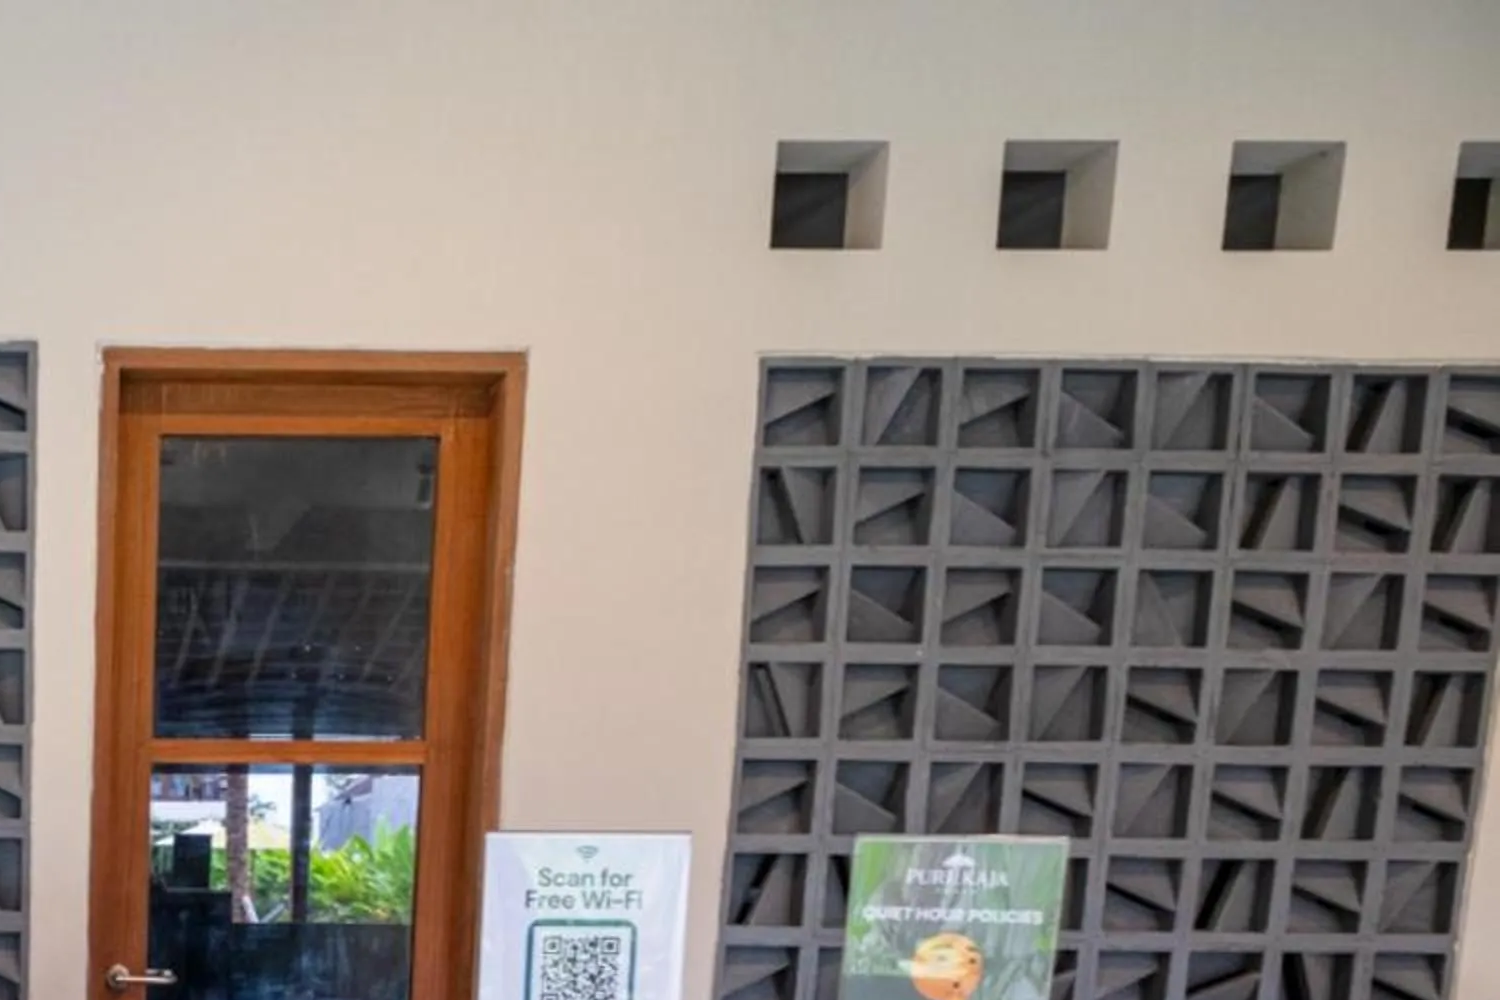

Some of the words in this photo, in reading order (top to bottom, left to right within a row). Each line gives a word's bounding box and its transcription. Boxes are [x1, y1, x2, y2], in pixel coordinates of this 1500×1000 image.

[537, 867, 596, 888] Scan
[600, 867, 634, 888] for
[524, 889, 576, 910] Free
[581, 889, 644, 910] Wi-Fi
[862, 906, 912, 922] QUIET
[915, 907, 964, 922] HOUR
[967, 909, 1043, 925] POLICIES
